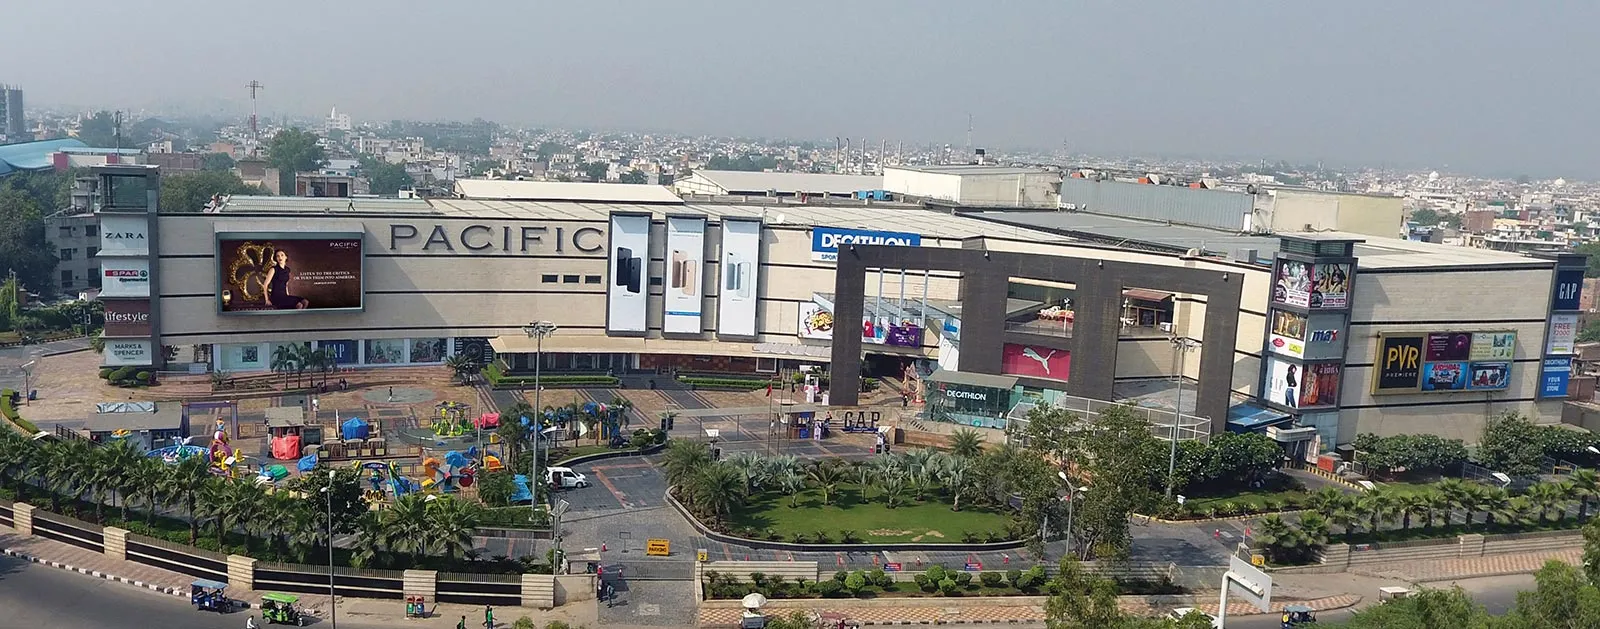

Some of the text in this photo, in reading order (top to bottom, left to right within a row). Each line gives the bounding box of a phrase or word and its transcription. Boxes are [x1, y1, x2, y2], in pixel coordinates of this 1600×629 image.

[389, 223, 605, 253] PACIFIC
[1559, 283, 1578, 300] GAP
[105, 311, 148, 322] lifestyle
[1554, 322, 1571, 330] FREE
[1310, 329, 1339, 343] max
[1386, 345, 1419, 371] PVR
[946, 390, 987, 401] DECATHLON
[844, 411, 881, 428] GAP
